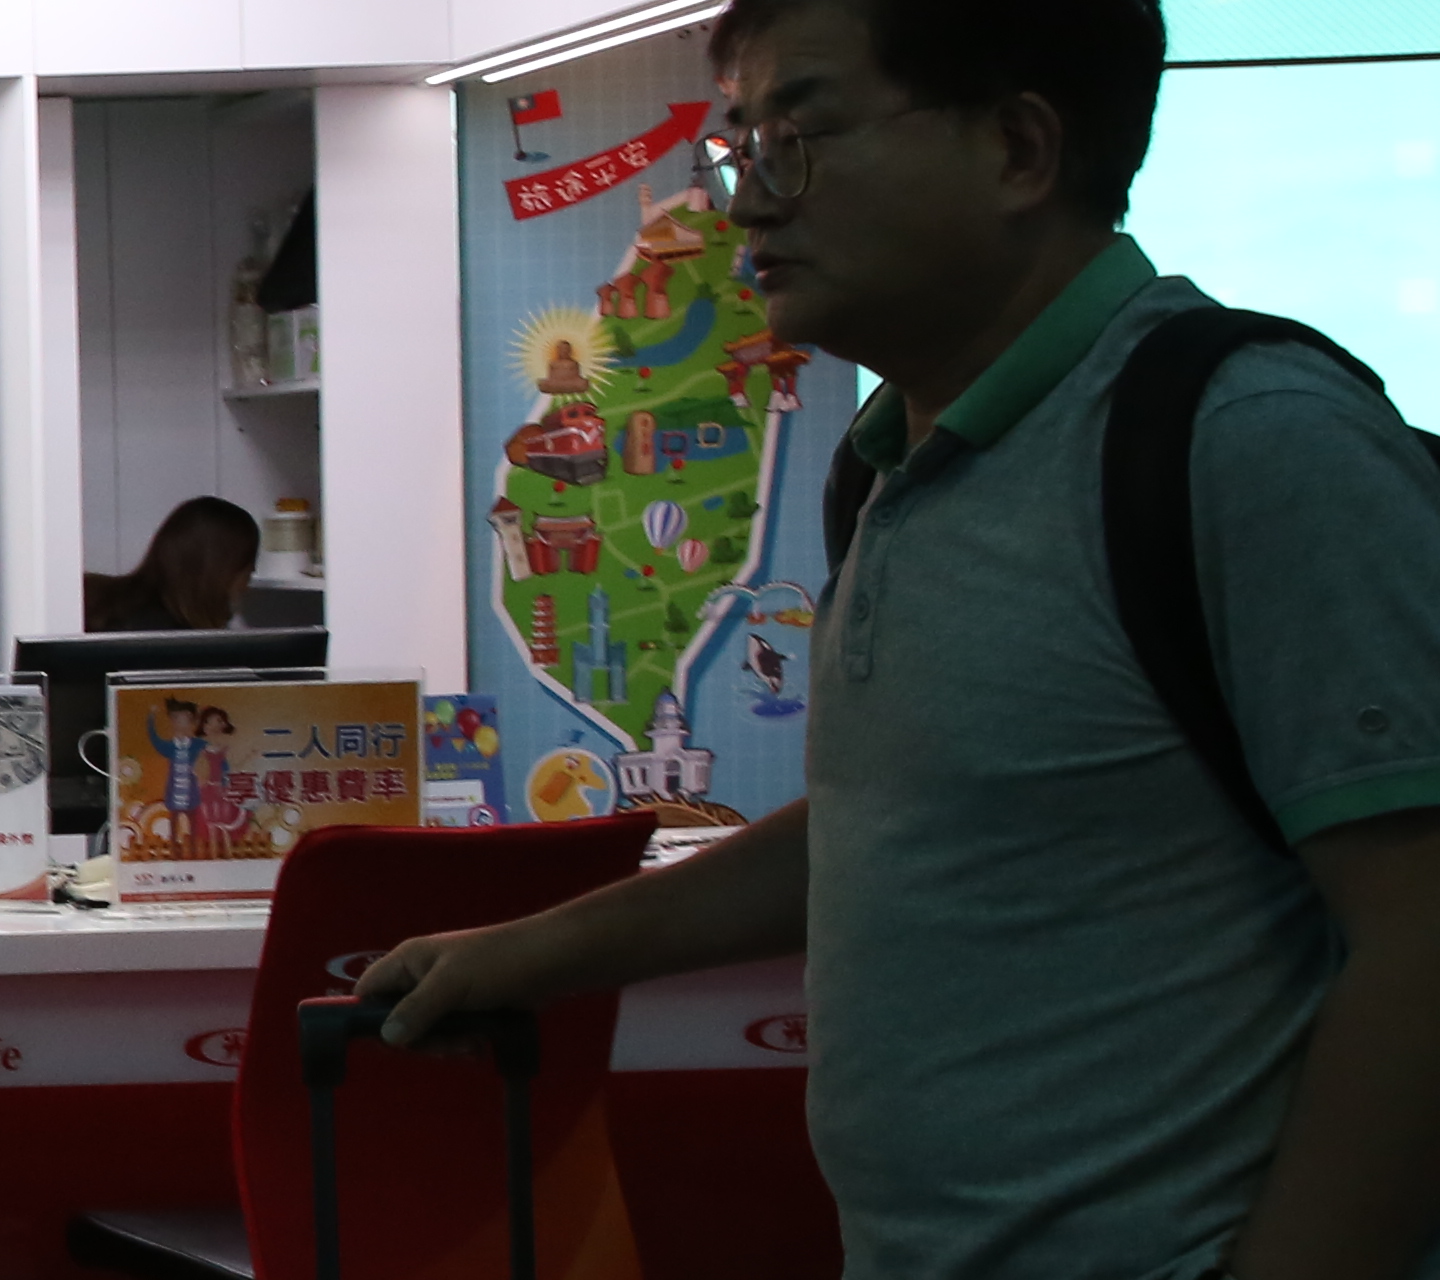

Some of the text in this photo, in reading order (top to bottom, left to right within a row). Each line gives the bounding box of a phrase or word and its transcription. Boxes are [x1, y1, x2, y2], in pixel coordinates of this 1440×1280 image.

[262, 722, 408, 760] 二人同行
[226, 767, 408, 807] 享優惠費率
